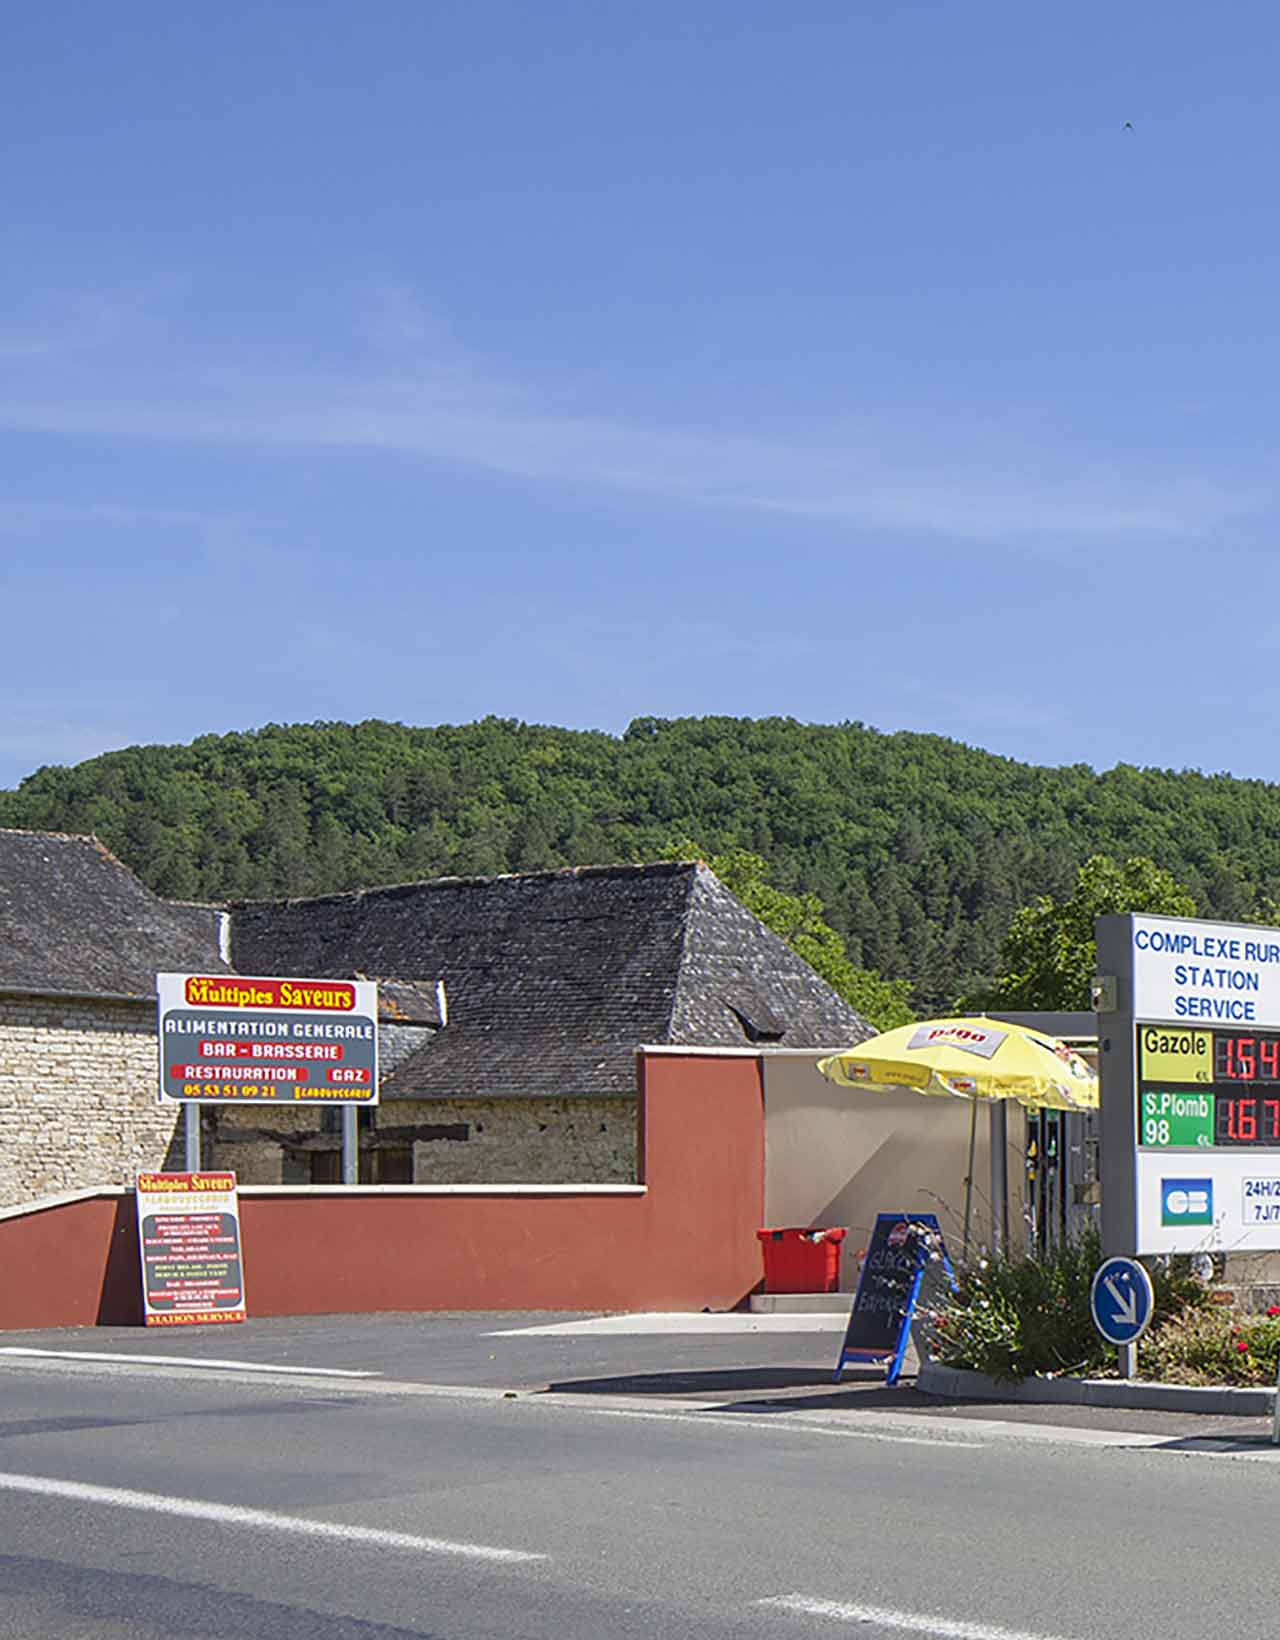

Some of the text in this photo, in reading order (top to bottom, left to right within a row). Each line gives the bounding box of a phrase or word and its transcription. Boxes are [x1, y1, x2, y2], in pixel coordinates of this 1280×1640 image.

[1135, 929, 1241, 960] COMPLEXE
[1174, 965, 1259, 991] STATION
[188, 982, 352, 1008] Multiples Saveurs
[1174, 996, 1256, 1020] SERVICE
[165, 1018, 373, 1039] ALIMENTATION GENERALE
[928, 1028, 987, 1042] pago
[203, 1043, 236, 1057] BAR
[252, 1043, 338, 1060] BRASSERIE
[1144, 1029, 1207, 1056] Gazole
[184, 1065, 364, 1081] RESTAURATION GAZ
[183, 1084, 276, 1098] 05 53 51 09 21
[1145, 1092, 1209, 1118] S.Plomb
[1145, 1119, 1170, 1145] 98
[1254, 1204, 1280, 1221] 7J/7
[148, 1311, 243, 1323] STATION SERVICE
